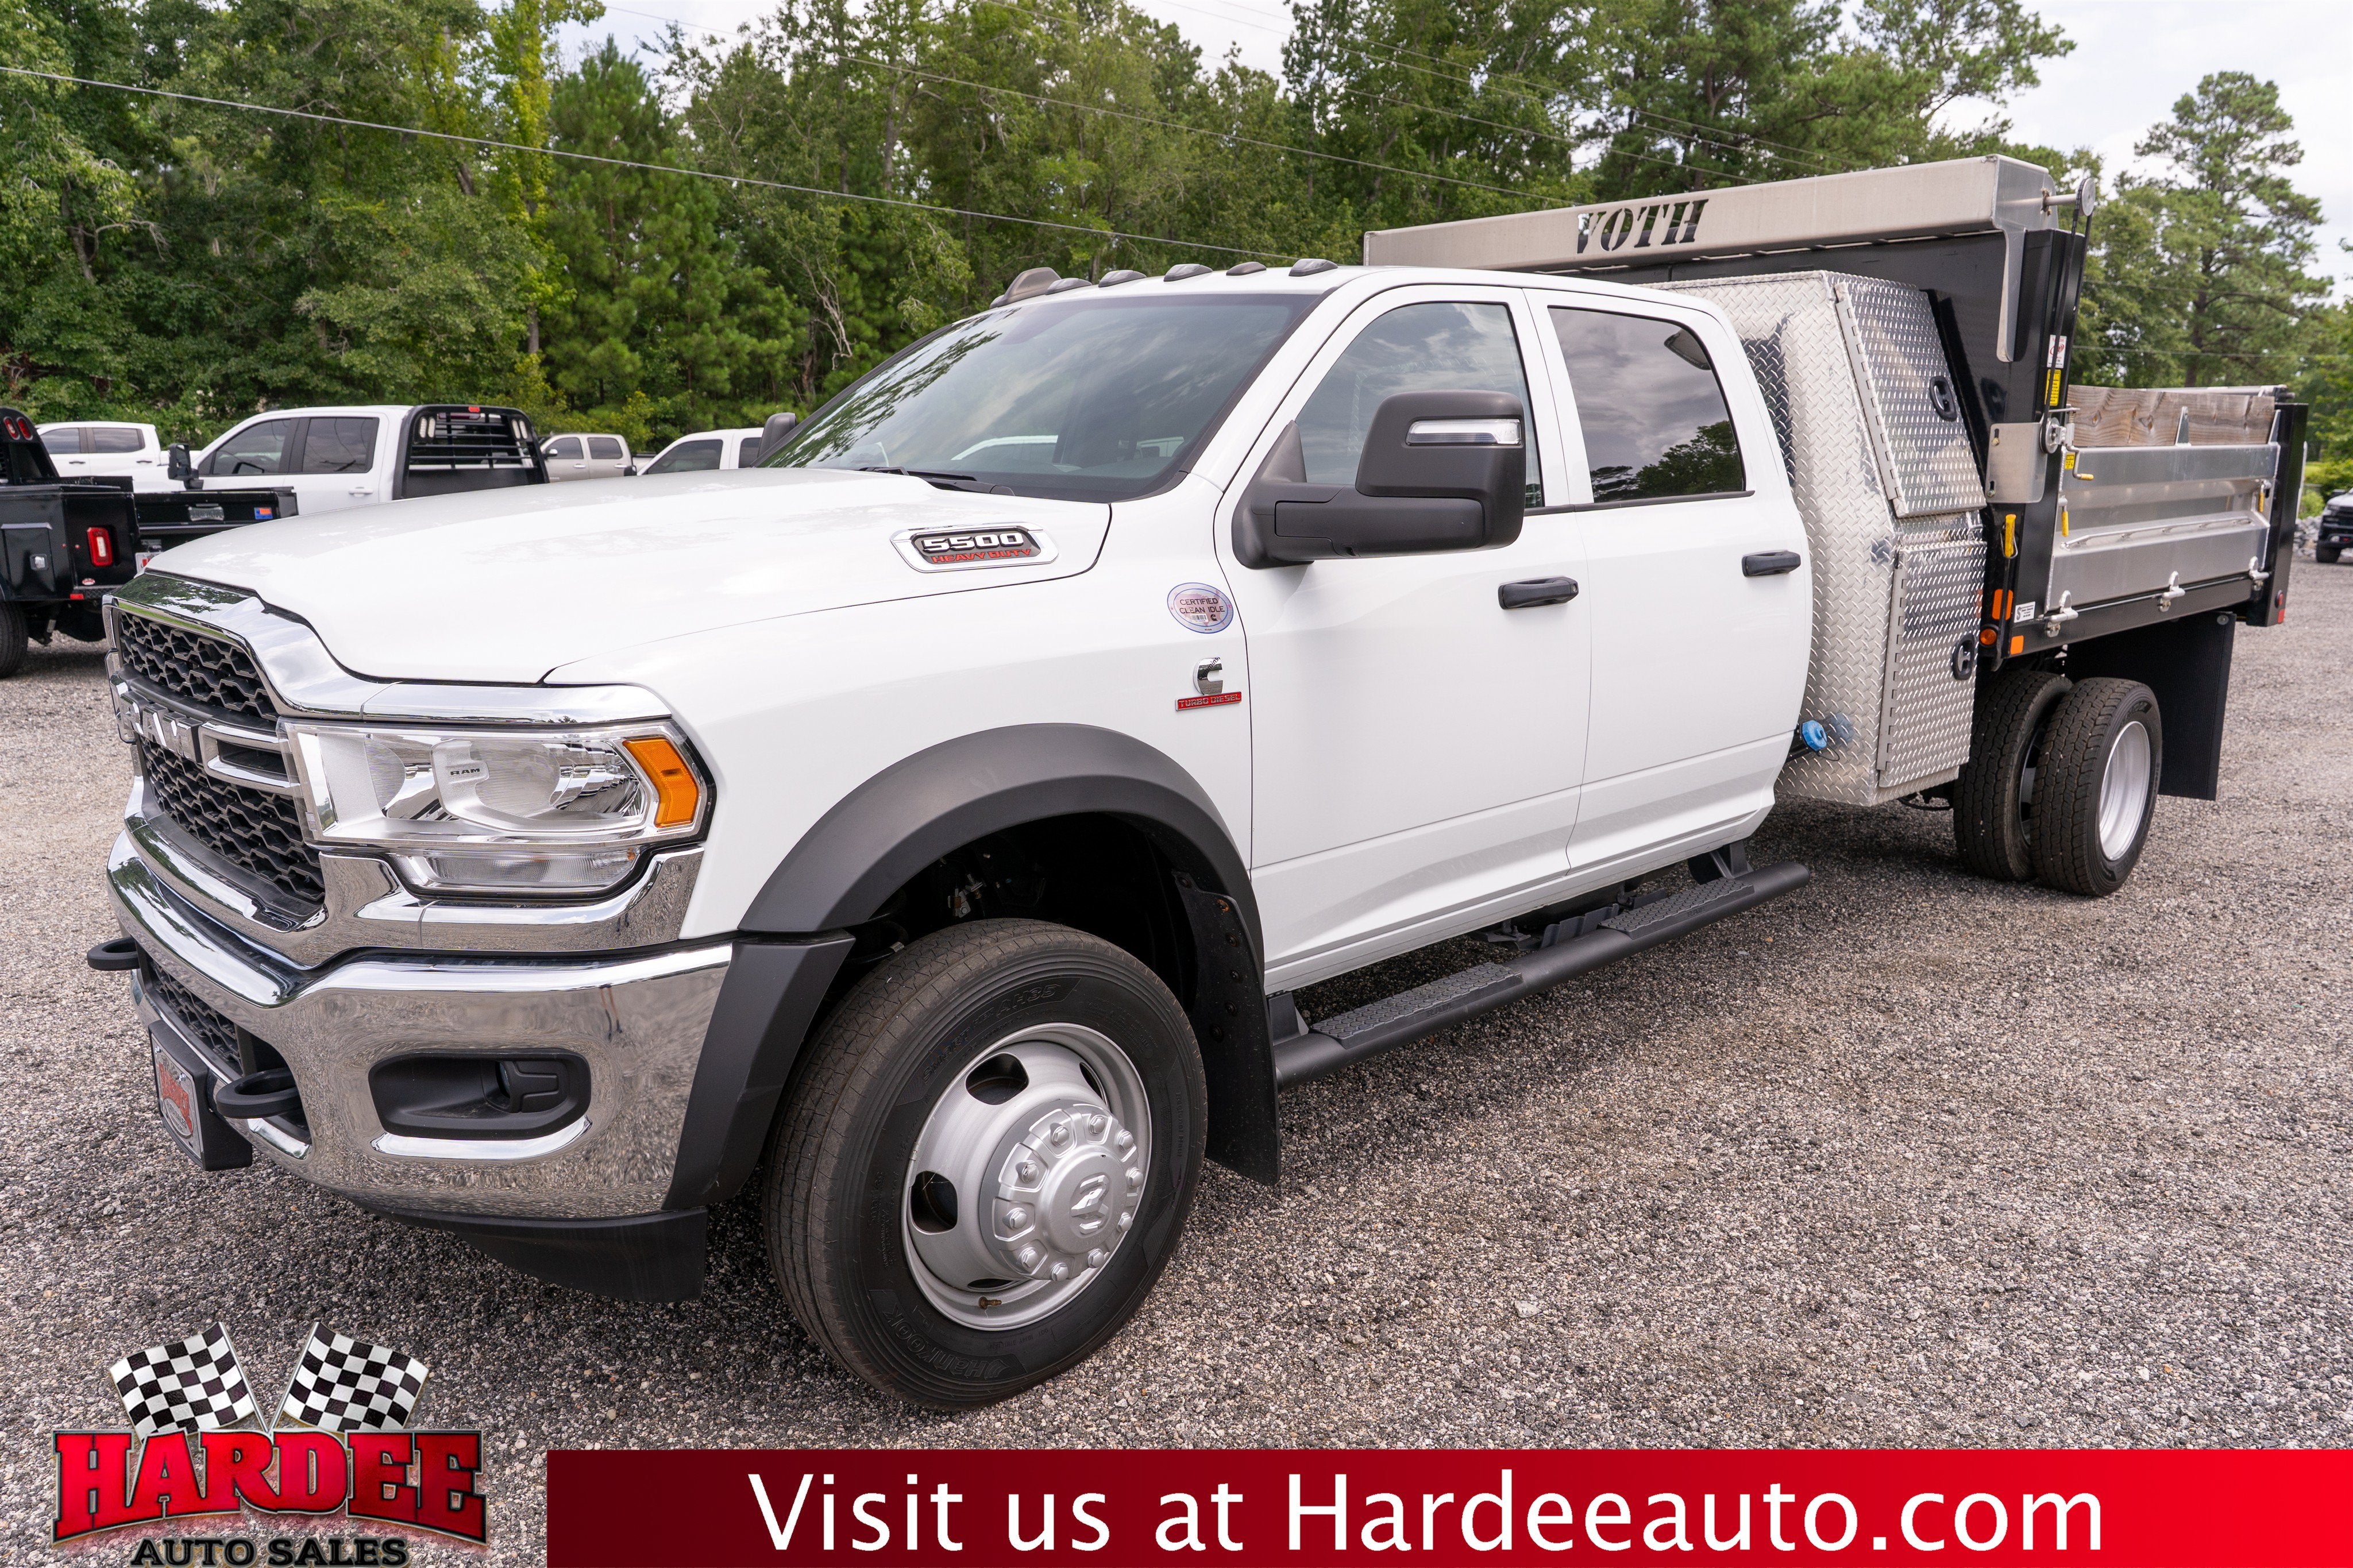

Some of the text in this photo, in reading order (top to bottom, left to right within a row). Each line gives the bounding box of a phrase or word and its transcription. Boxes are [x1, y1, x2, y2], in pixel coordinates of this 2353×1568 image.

[1576, 199, 1709, 254] VOTH
[921, 532, 1025, 553] 5500
[931, 549, 1032, 563] HEAVY DUTY
[1179, 694, 1241, 708] TURBO DIESEL
[119, 692, 199, 763] RAM
[450, 767, 480, 775] RAM
[996, 984, 1060, 1019] AH35
